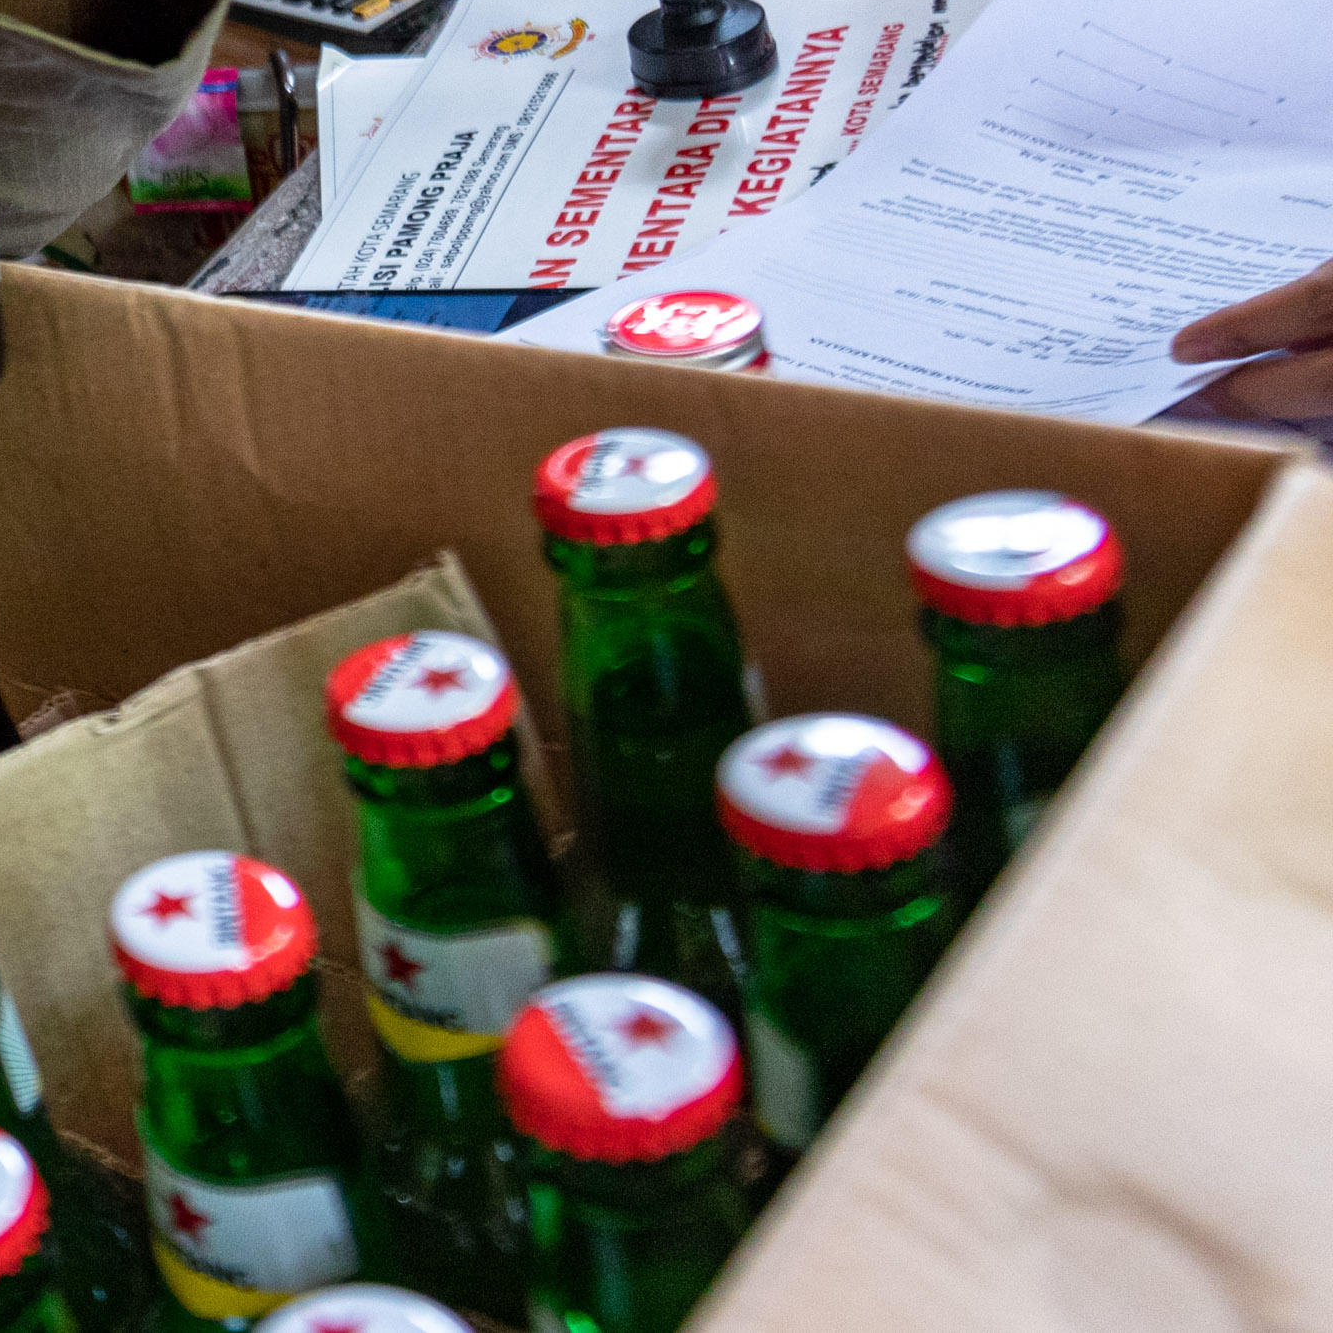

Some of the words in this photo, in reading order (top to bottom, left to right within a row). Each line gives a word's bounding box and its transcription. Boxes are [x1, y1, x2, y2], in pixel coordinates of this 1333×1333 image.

[858, 21, 905, 96] SEMARANG
[471, 124, 512, 168] Semarang
[727, 24, 850, 217] KEGIATANNYA
[841, 99, 876, 136] KOTA
[353, 230, 388, 269] KOTA
[371, 171, 421, 235] SEMARANG
[386, 186, 444, 259] PAMONG
[428, 130, 479, 183] PRAJA
